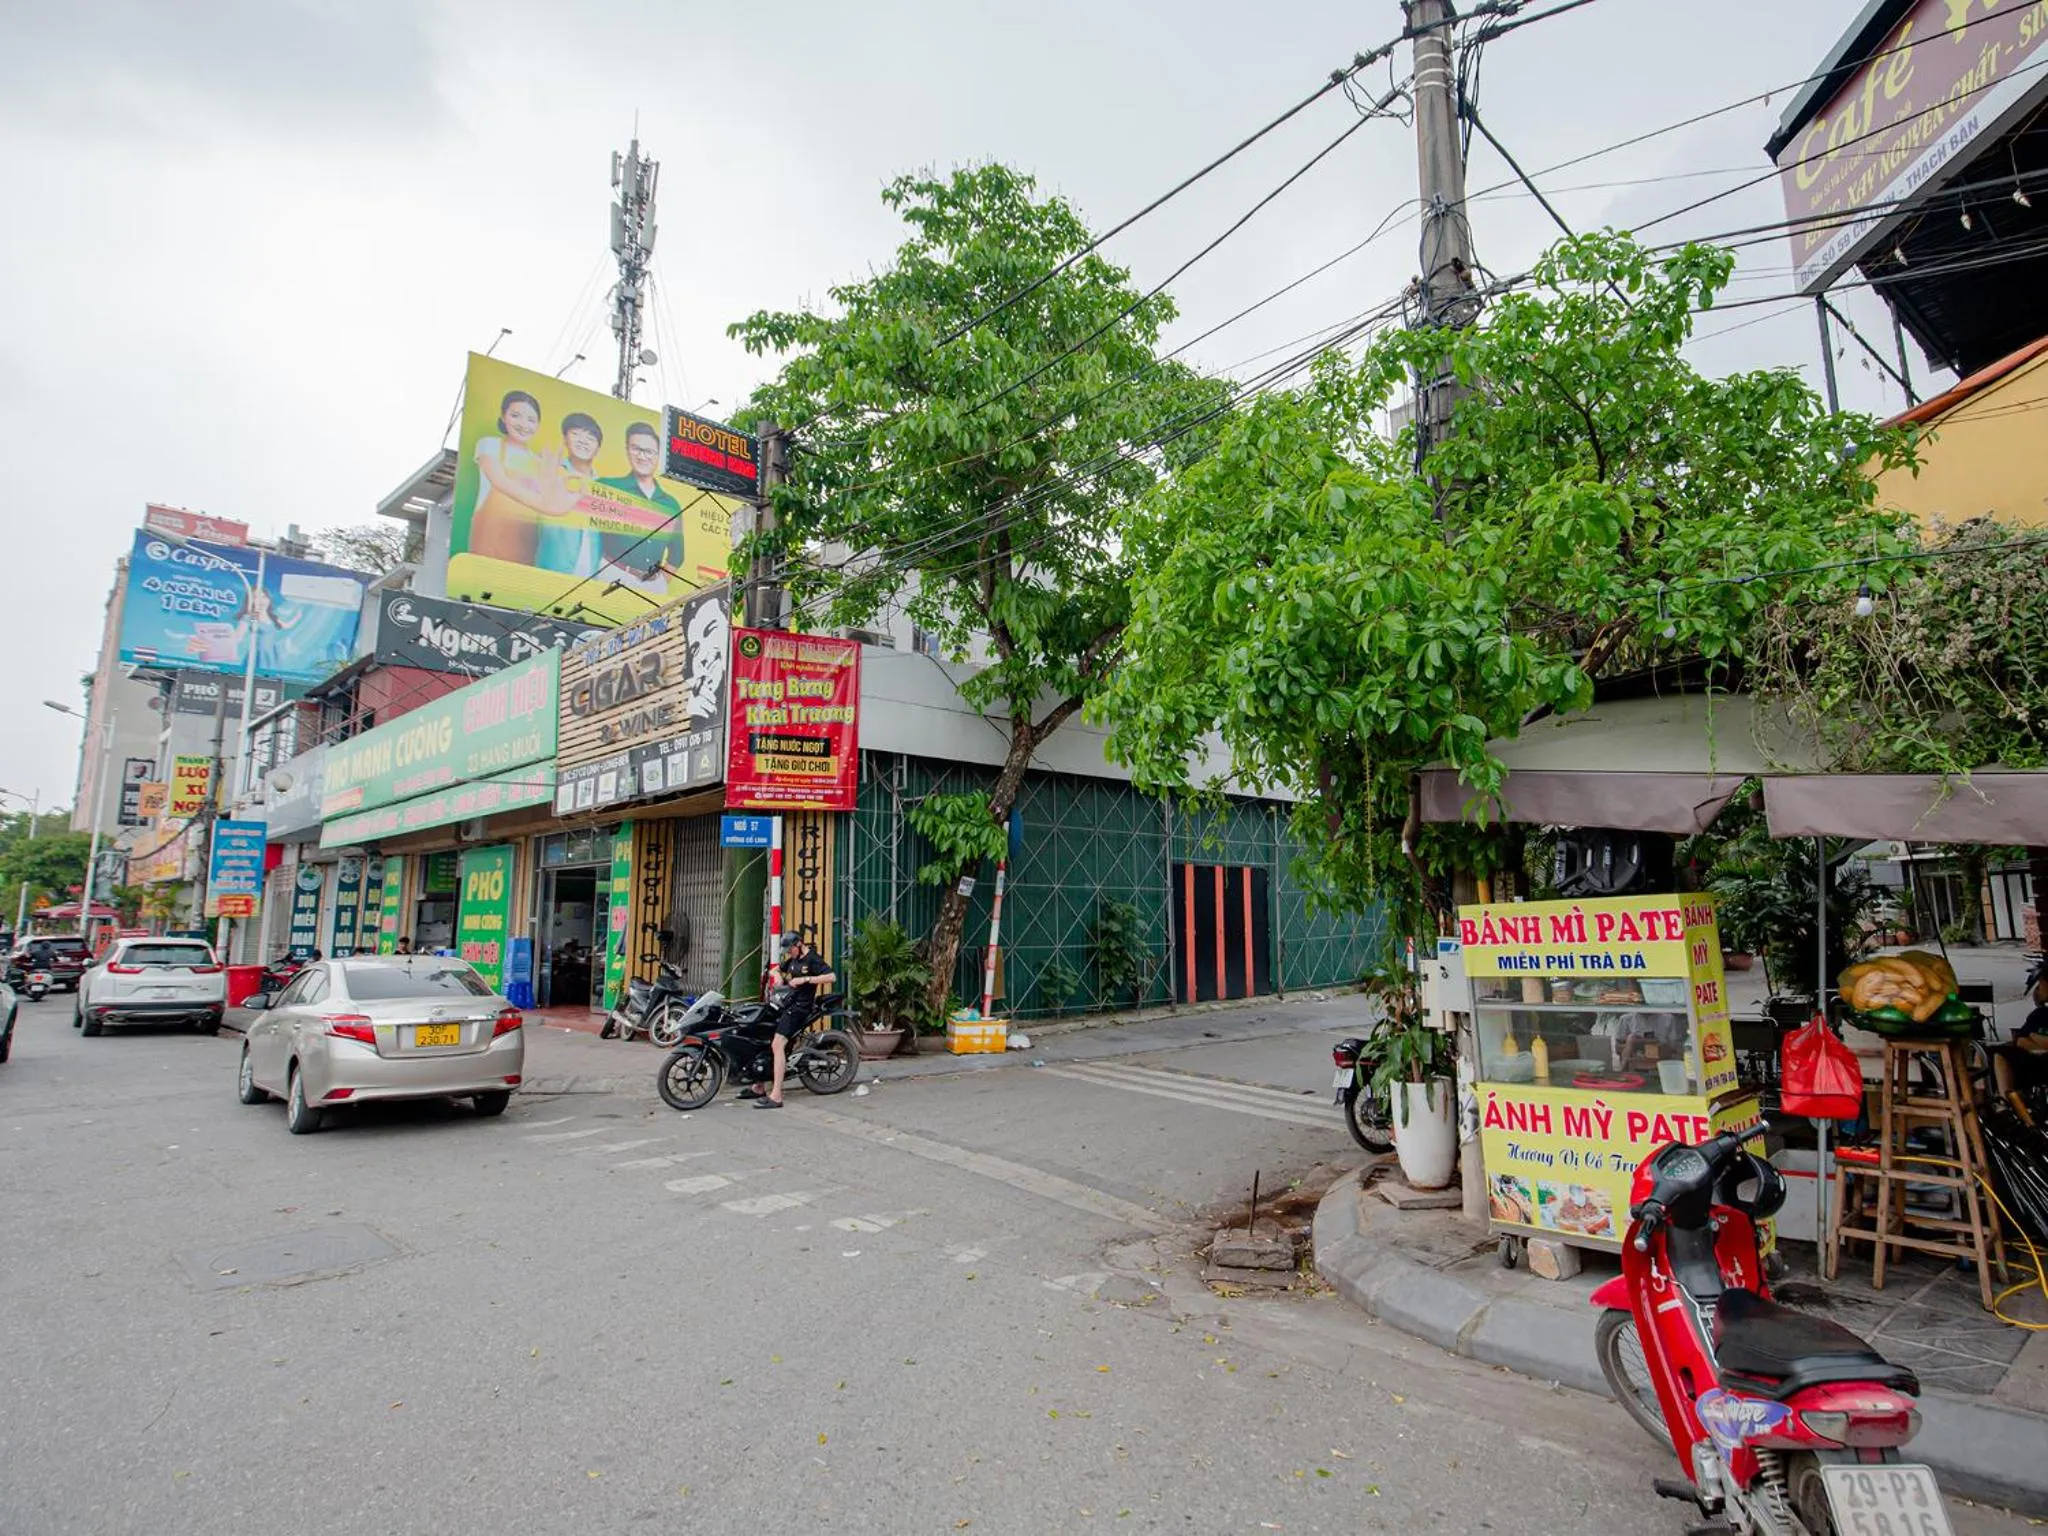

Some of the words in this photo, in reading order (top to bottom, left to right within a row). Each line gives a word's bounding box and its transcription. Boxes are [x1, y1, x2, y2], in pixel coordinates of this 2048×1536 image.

[1796, 21, 1915, 191] Café
[1848, 162, 1878, 209] XAY
[1949, 41, 2000, 113] CHẤT
[678, 415, 751, 460] HOTEL
[170, 548, 242, 572] Casper
[143, 576, 161, 592] 4
[161, 593, 174, 611] 1
[419, 616, 498, 657] Ngan
[571, 652, 663, 716] CIGAR
[736, 677, 784, 702] Tưng
[787, 674, 835, 701] Bừng
[618, 702, 675, 737] WINE
[746, 702, 788, 725] Khai
[789, 703, 855, 725] Trương
[396, 715, 454, 767] CƯỜNG
[756, 737, 779, 752] TẶNG
[780, 738, 802, 751] NƯỚC
[803, 742, 825, 755] NGỌT
[765, 758, 789, 772] TẶNG
[791, 758, 807, 771] GIỜ
[808, 761, 830, 772] CHƠI
[616, 841, 633, 861] PH
[466, 857, 504, 901] PHỞ
[1461, 910, 1543, 946] BÁNH
[1549, 906, 1588, 943] MÌ
[1594, 909, 1685, 942] PATE
[1684, 900, 1713, 928] BÁNH
[1545, 951, 1575, 969] PHÍ
[1620, 950, 1647, 969] ĐÁ
[1693, 938, 1709, 966] MỲ
[1696, 981, 1719, 1005] PATE
[1484, 1091, 1552, 1135] ÁNH
[1563, 1100, 1614, 1141] MỲ
[1507, 1142, 1554, 1167] Hương
[1726, 1399, 1767, 1423] Wave
[1841, 1472, 1929, 1508] 29-P3
